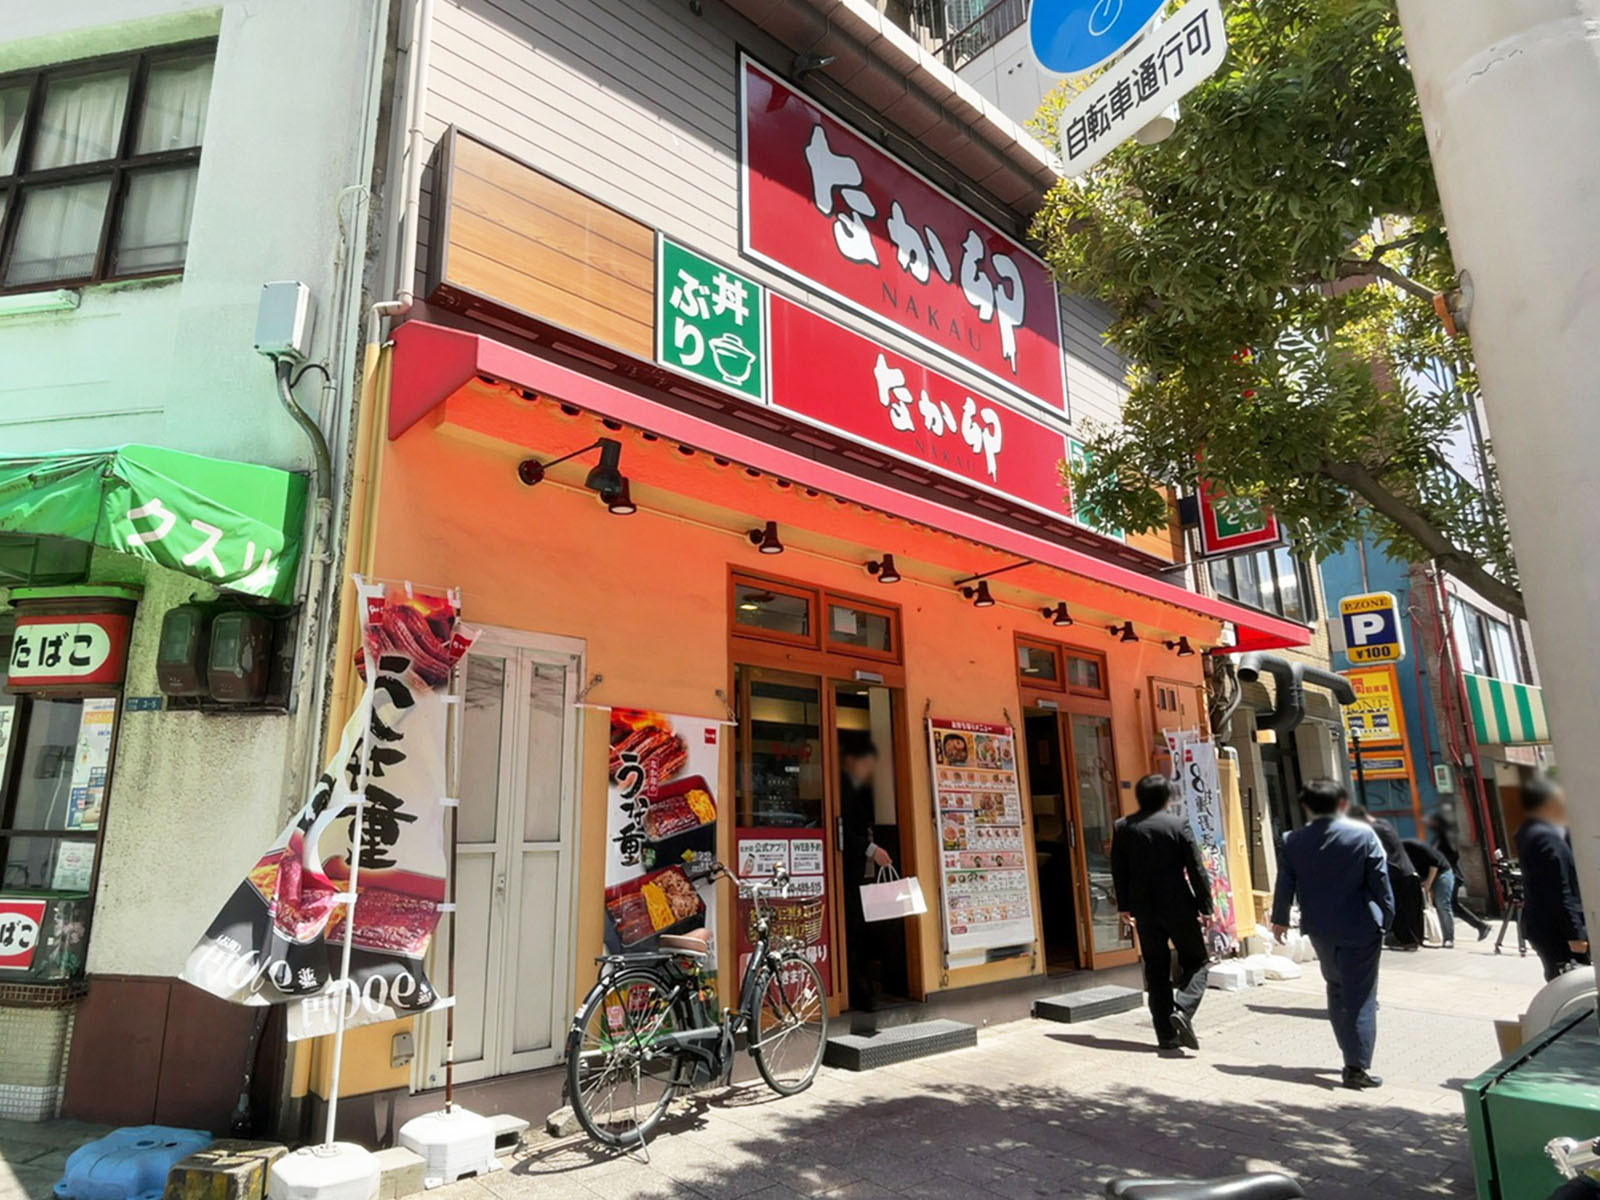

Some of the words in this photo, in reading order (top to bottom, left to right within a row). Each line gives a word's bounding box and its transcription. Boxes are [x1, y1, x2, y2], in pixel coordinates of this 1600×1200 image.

[1066, 8, 1211, 160] 自転車通行可
[804, 123, 1026, 374] なか卯
[881, 281, 983, 352] NAKAU
[873, 352, 1003, 484] なか卯
[127, 497, 276, 580] クスリ
[11, 631, 93, 669] たばこ
[1350, 612, 1385, 645] P
[612, 752, 650, 867] うな重
